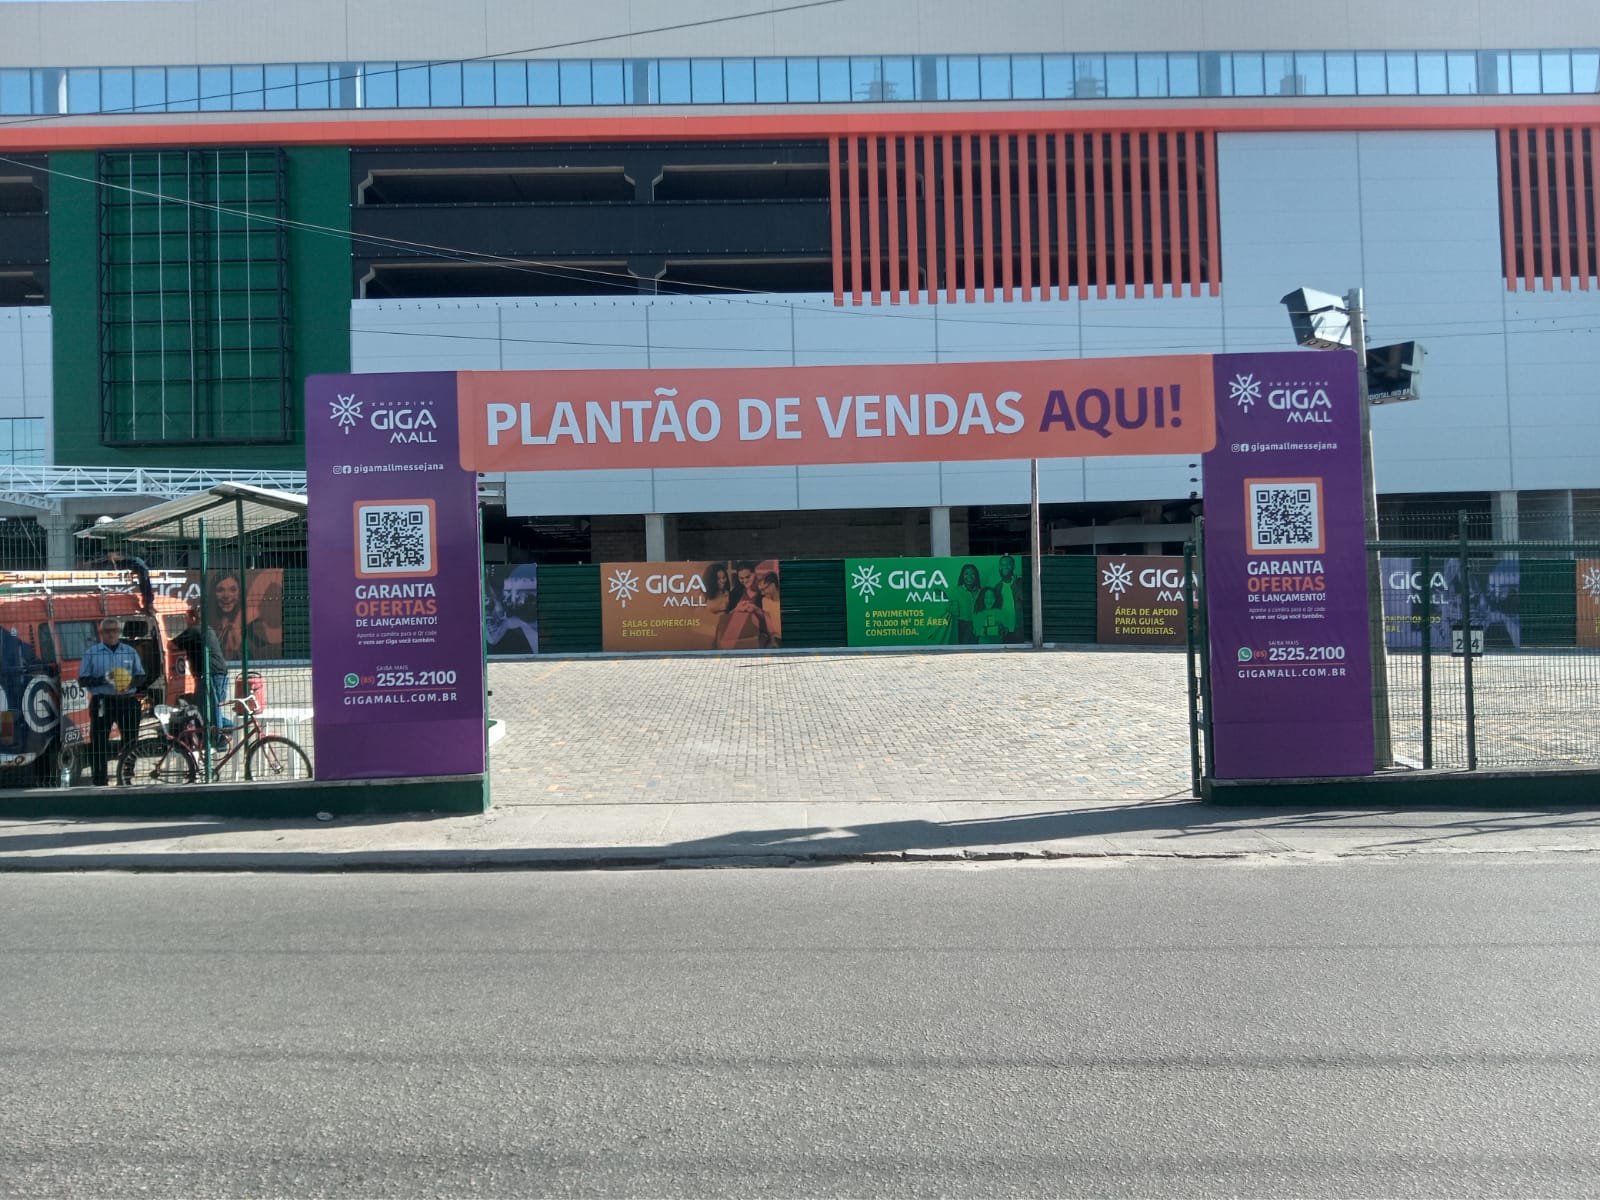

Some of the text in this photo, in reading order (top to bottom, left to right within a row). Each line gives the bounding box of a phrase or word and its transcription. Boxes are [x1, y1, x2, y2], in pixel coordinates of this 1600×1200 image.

[1267, 389, 1333, 410] GIGA
[370, 409, 438, 430] GIGA
[486, 384, 1182, 446] PLANTÃO DE VENDAS AQUI!
[1286, 411, 1333, 423] MALL
[389, 431, 438, 444] MALL
[1251, 441, 1338, 452] gigamallmessejana
[353, 462, 444, 473] gigamallmessejana
[1247, 560, 1325, 576] GARANTA
[645, 573, 707, 594] GIGA
[888, 569, 949, 590] GIGA
[1247, 576, 1326, 592] OFERTAS
[355, 583, 436, 600] GARANTA
[905, 590, 949, 603] MALL
[663, 595, 708, 607] MALL
[1248, 592, 1326, 604] DE LANÇAMENTO!
[1406, 593, 1448, 605] MLL
[355, 599, 438, 618] OFERTAS
[865, 609, 924, 619] 6 PAVIMENTOS
[1115, 606, 1178, 616] ÁREA DE APOIO
[356, 616, 438, 629] DE LANÇAMENTO!
[622, 618, 701, 628] SALAS COMERCIAIS
[873, 619, 899, 627] 70.000
[913, 618, 925, 626] DE
[927, 616, 949, 626] ÁREA
[1115, 617, 1165, 626] PARA GUIAS
[622, 628, 657, 637] E HOTEL.
[865, 626, 919, 637] CONSTRUÍDA.
[1115, 626, 1177, 635] E MOTORISTAS.
[1269, 646, 1345, 661] 2525.2100
[377, 671, 457, 687] 2525.2100
[1238, 668, 1347, 679] GIGAMALL.COM.BR
[343, 692, 457, 705] GIGAMALL.COM.BR
